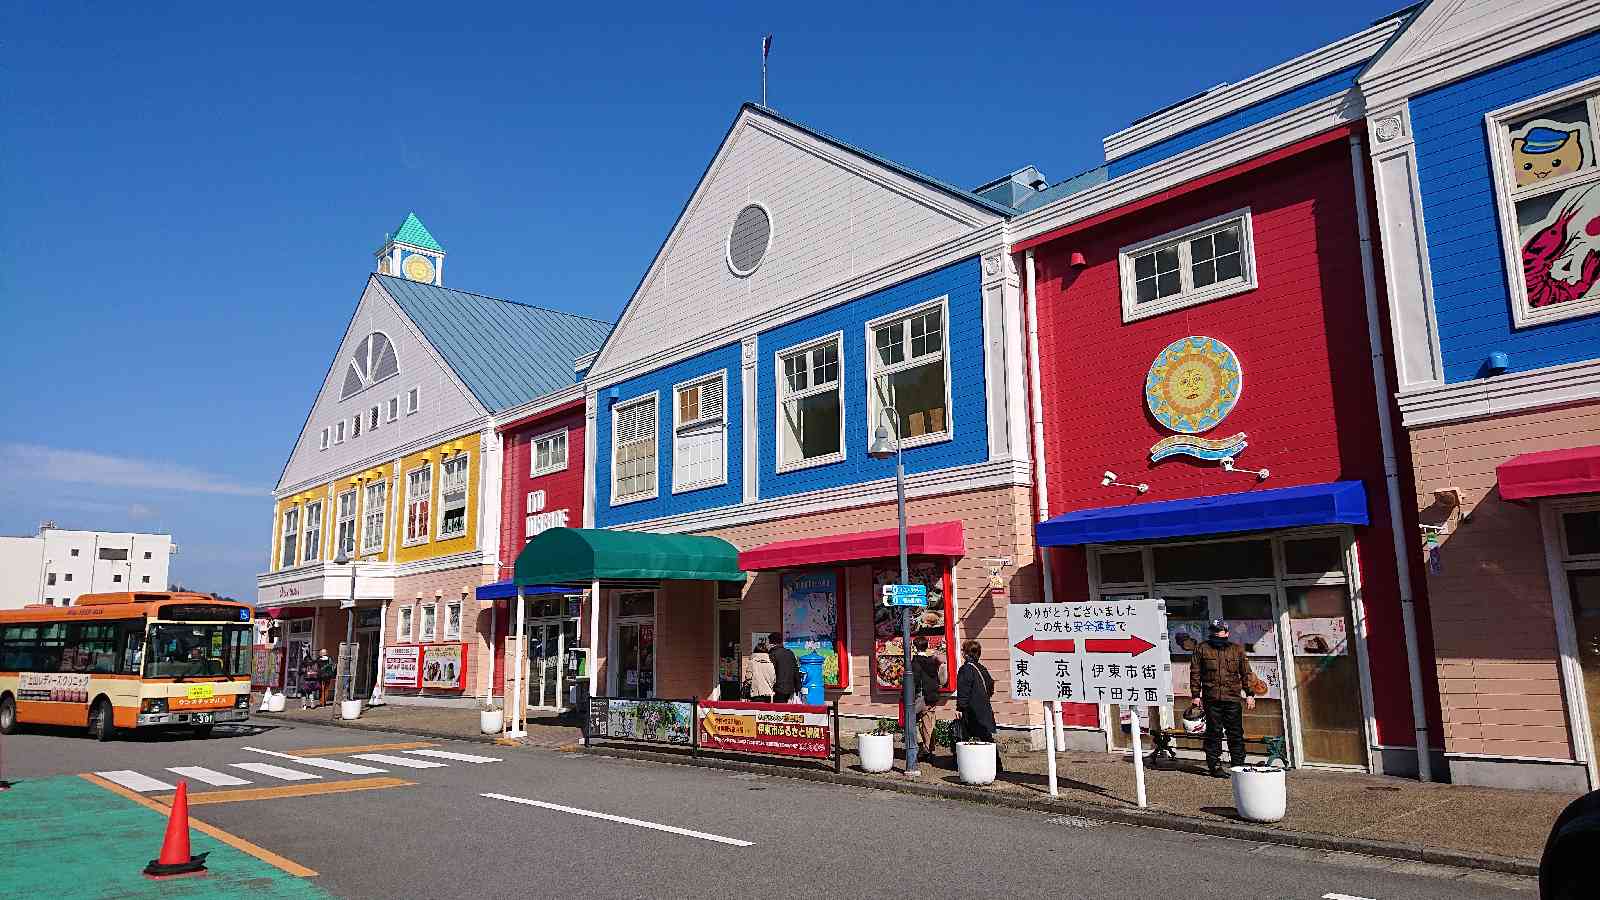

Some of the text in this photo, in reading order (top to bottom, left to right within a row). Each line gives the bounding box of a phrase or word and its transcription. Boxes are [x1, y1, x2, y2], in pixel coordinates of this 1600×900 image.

[1024, 605, 1137, 619] ありがとうございました
[1034, 621, 1127, 633] この先も安全運転で
[1091, 664, 1157, 679] 伊東市街
[1094, 686, 1158, 701] 下田方面
